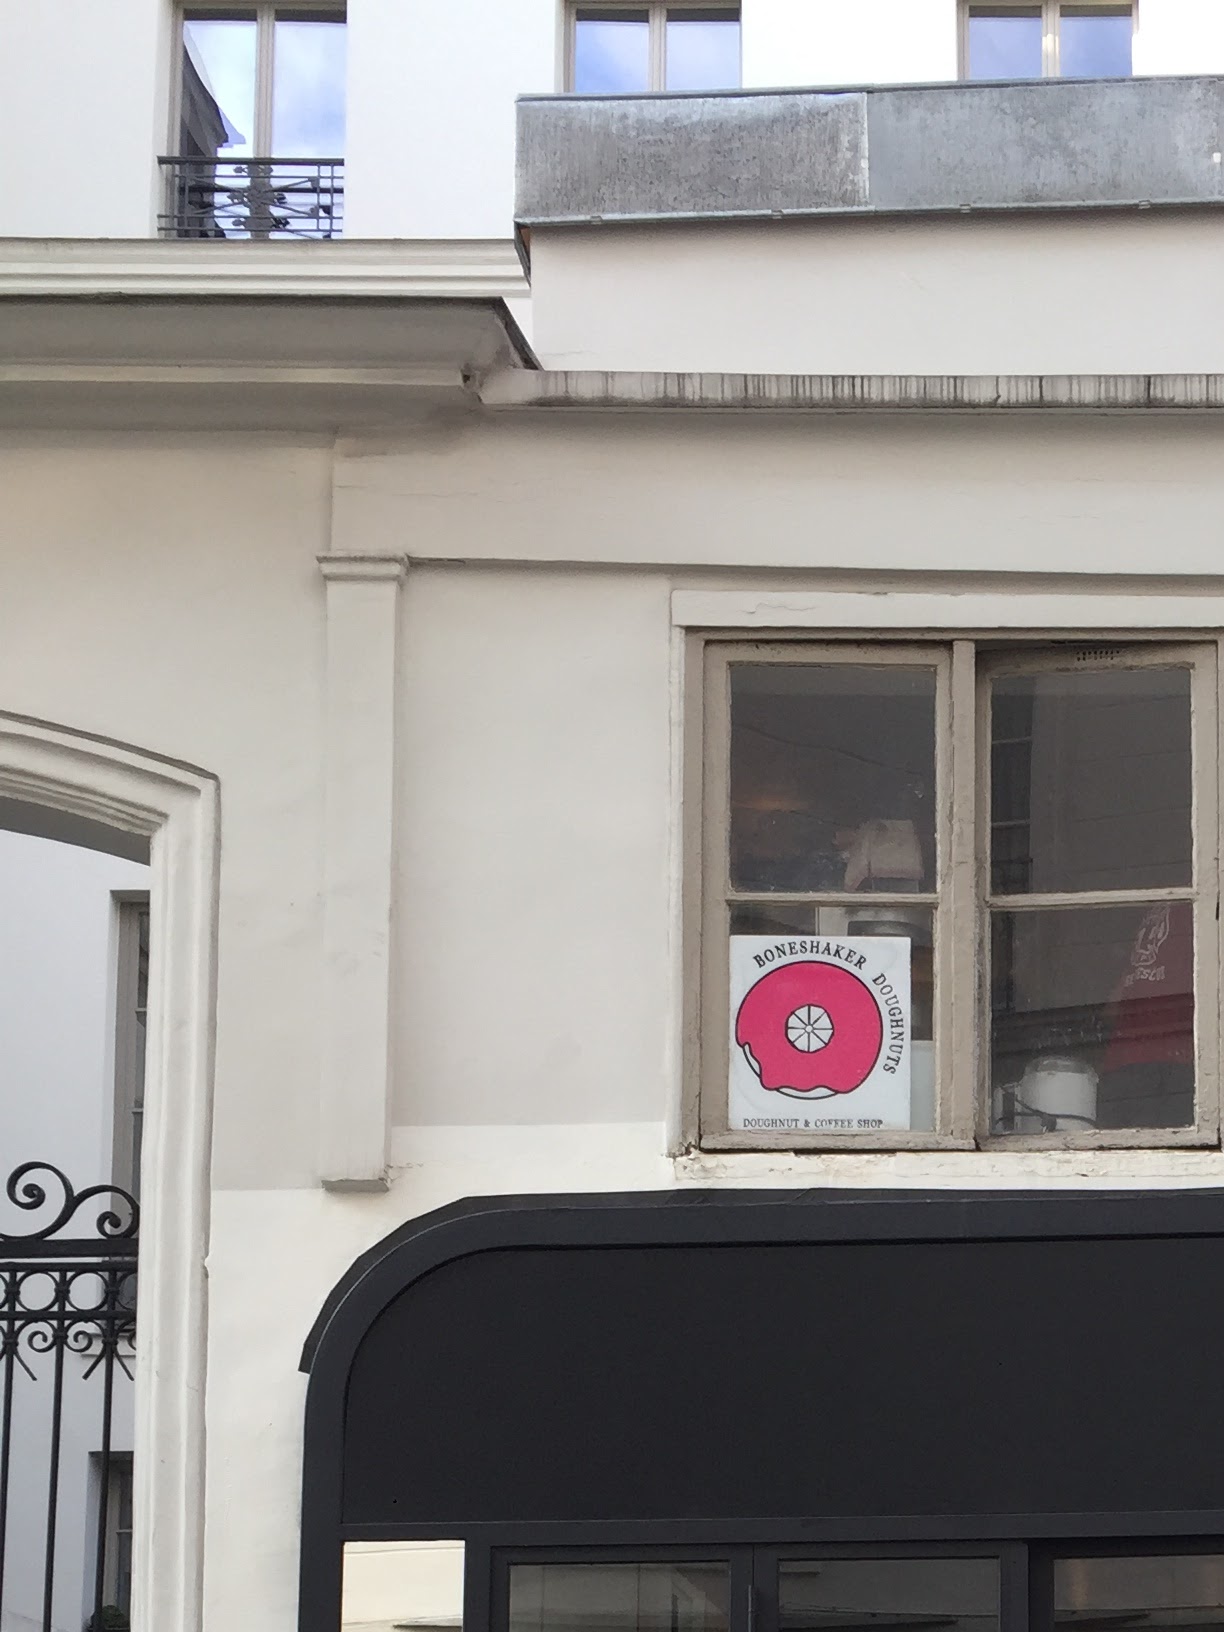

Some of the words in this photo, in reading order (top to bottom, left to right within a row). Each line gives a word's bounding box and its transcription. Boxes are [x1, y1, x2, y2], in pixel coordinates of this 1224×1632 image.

[752, 940, 867, 970] BONESHAKER
[872, 972, 905, 1075] DOUGHNUTS
[743, 1118, 799, 1128] DOUGHNUT
[803, 1119, 811, 1128] &
[814, 1119, 853, 1129] COFFEE
[857, 1119, 884, 1129] SHOP
